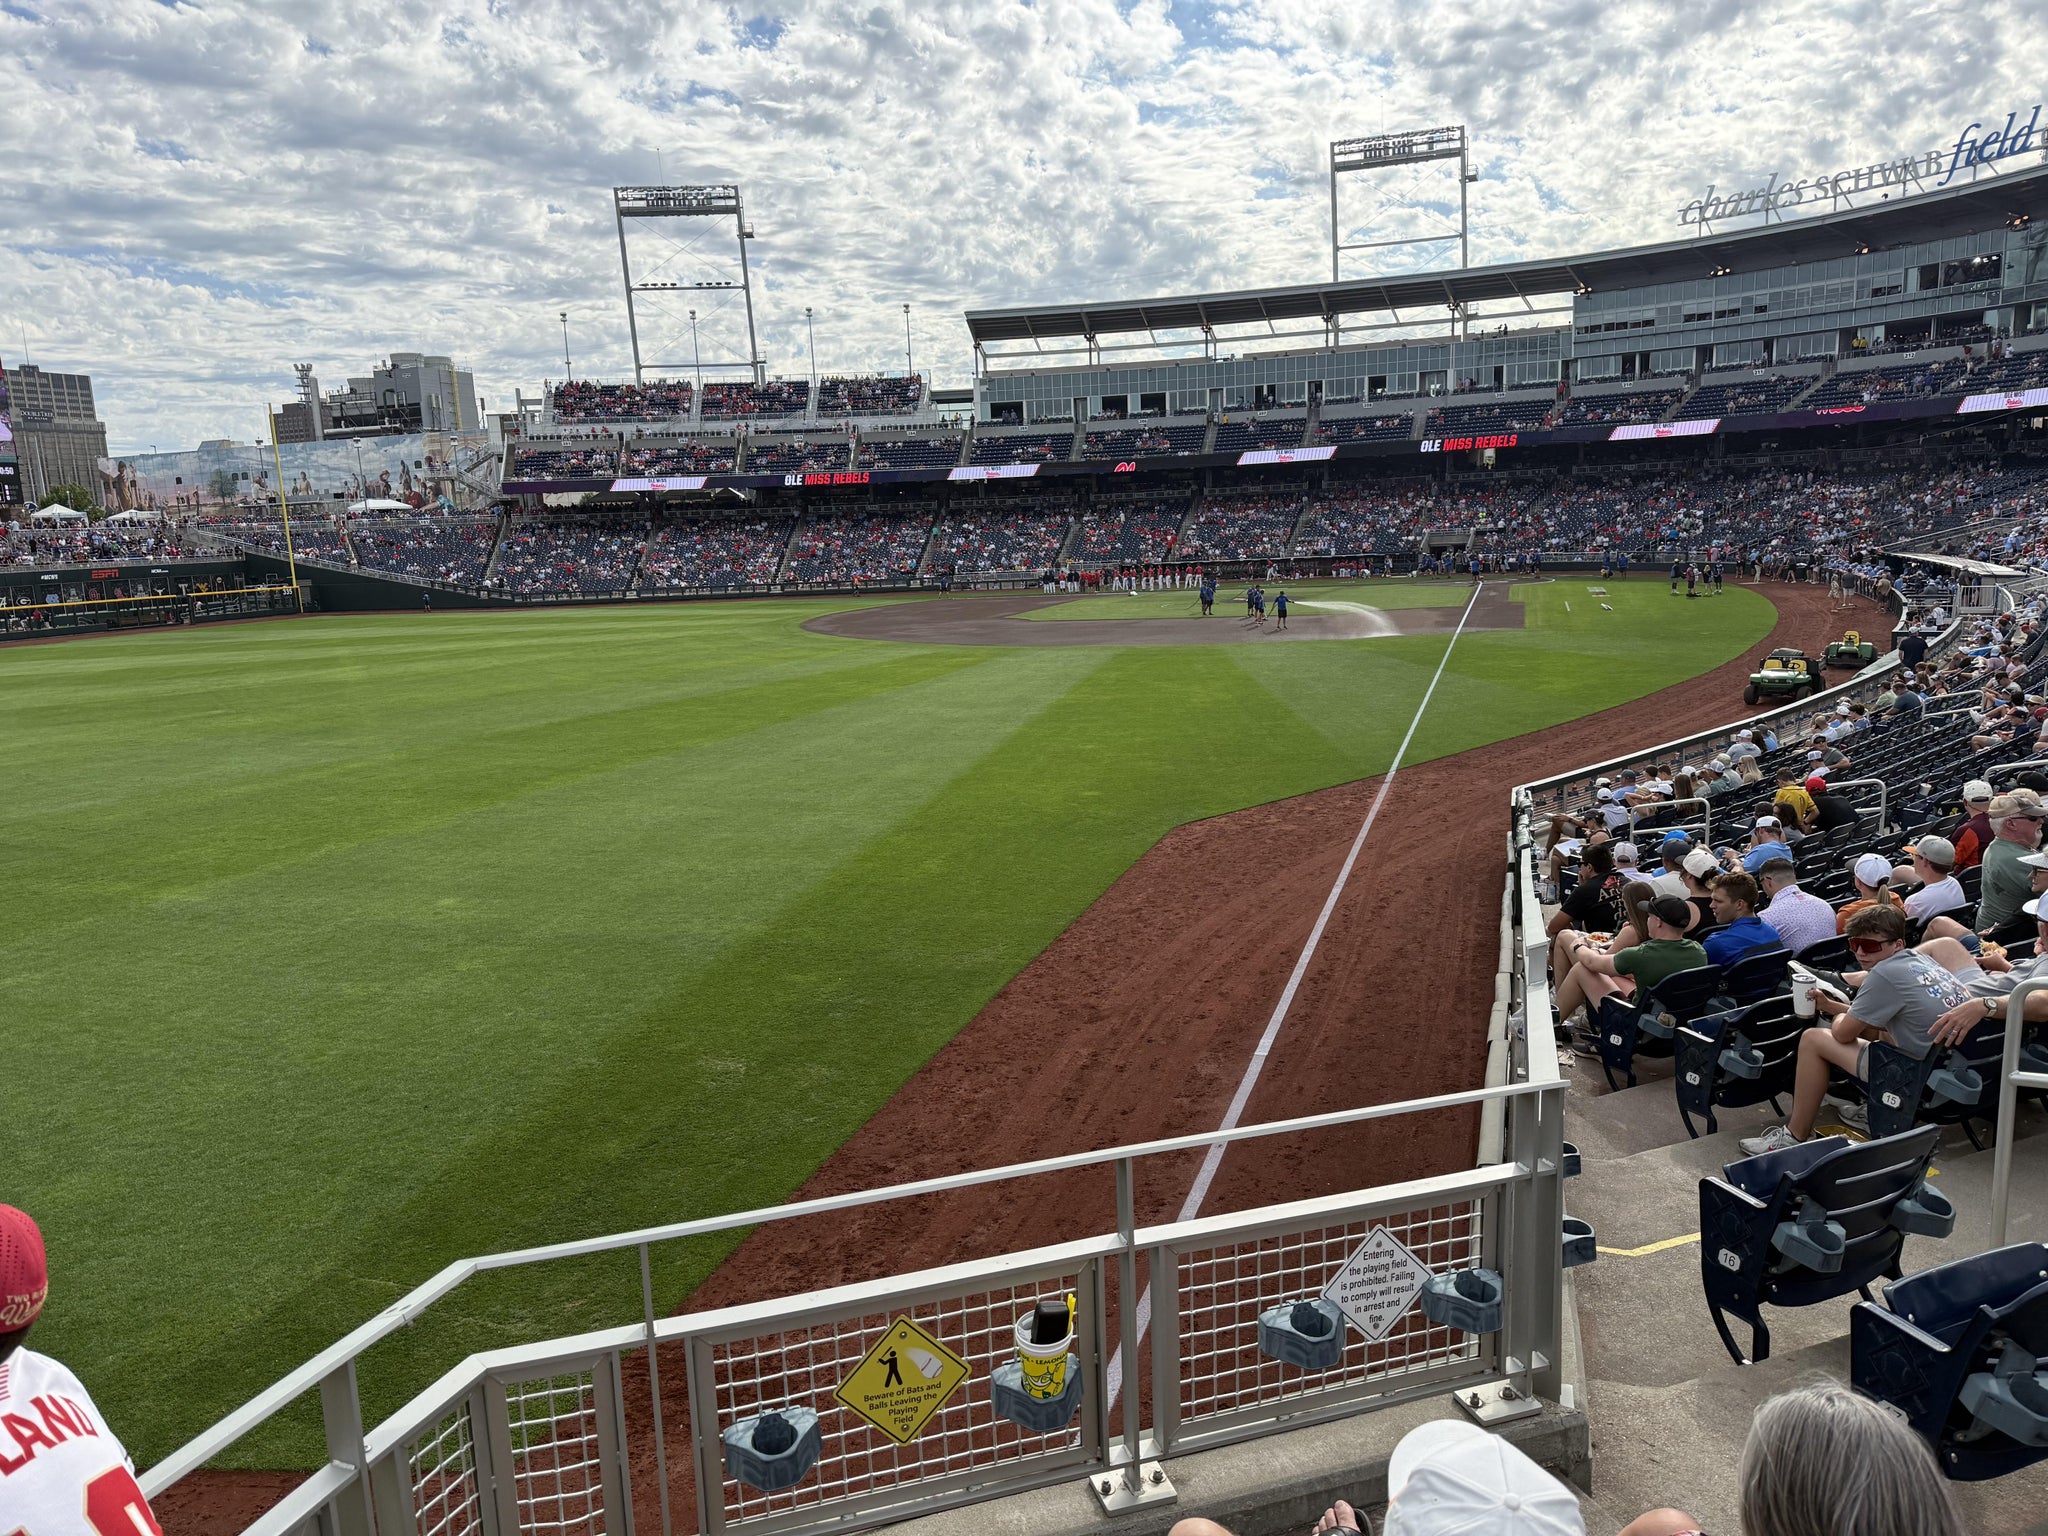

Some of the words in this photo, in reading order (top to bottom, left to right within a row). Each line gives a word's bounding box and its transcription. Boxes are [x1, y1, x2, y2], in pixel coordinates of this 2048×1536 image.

[1681, 172, 1808, 225] charles
[1813, 150, 1943, 201] SCHWAB
[1937, 104, 2042, 187] field
[1420, 440, 1440, 453] OLE
[1442, 438, 1472, 451] MISS
[1475, 434, 1518, 449] REBELS
[784, 475, 802, 486] OLE
[804, 473, 831, 485] MISS
[833, 472, 869, 484] REBELS
[91, 569, 119, 579] ESPN
[1612, 1036, 1620, 1044] 13
[1689, 1073, 1697, 1083] 14
[1886, 1094, 1897, 1106] 15
[1363, 1249, 1395, 1261] Entering
[1723, 1252, 1737, 1268] 16
[1349, 1267, 1361, 1277] the
[1363, 1262, 1390, 1276] playing
[1391, 1258, 1408, 1268] field
[1340, 1282, 1348, 1291] is
[1349, 1276, 1389, 1291] prohibited.
[1390, 1270, 1415, 1282] Failing
[6, 1294, 30, 1304] TWO
[1341, 1295, 1349, 1304] to
[1350, 1289, 1377, 1302] comply
[1379, 1286, 1392, 1297] will
[1393, 1283, 1415, 1294] result
[1354, 1304, 1362, 1314] in
[1363, 1302, 1385, 1312] arrest
[1386, 1297, 1401, 1308] and
[1369, 1314, 1385, 1324] fine.
[863, 1391, 895, 1403] Beware
[896, 1387, 905, 1396] of
[906, 1385, 925, 1394] Bats
[926, 1381, 942, 1391] and
[869, 1400, 888, 1411] Balls
[890, 1396, 922, 1407] Leaving
[923, 1391, 938, 1401] the
[888, 1406, 919, 1417] Playing
[893, 1415, 914, 1425] Field
